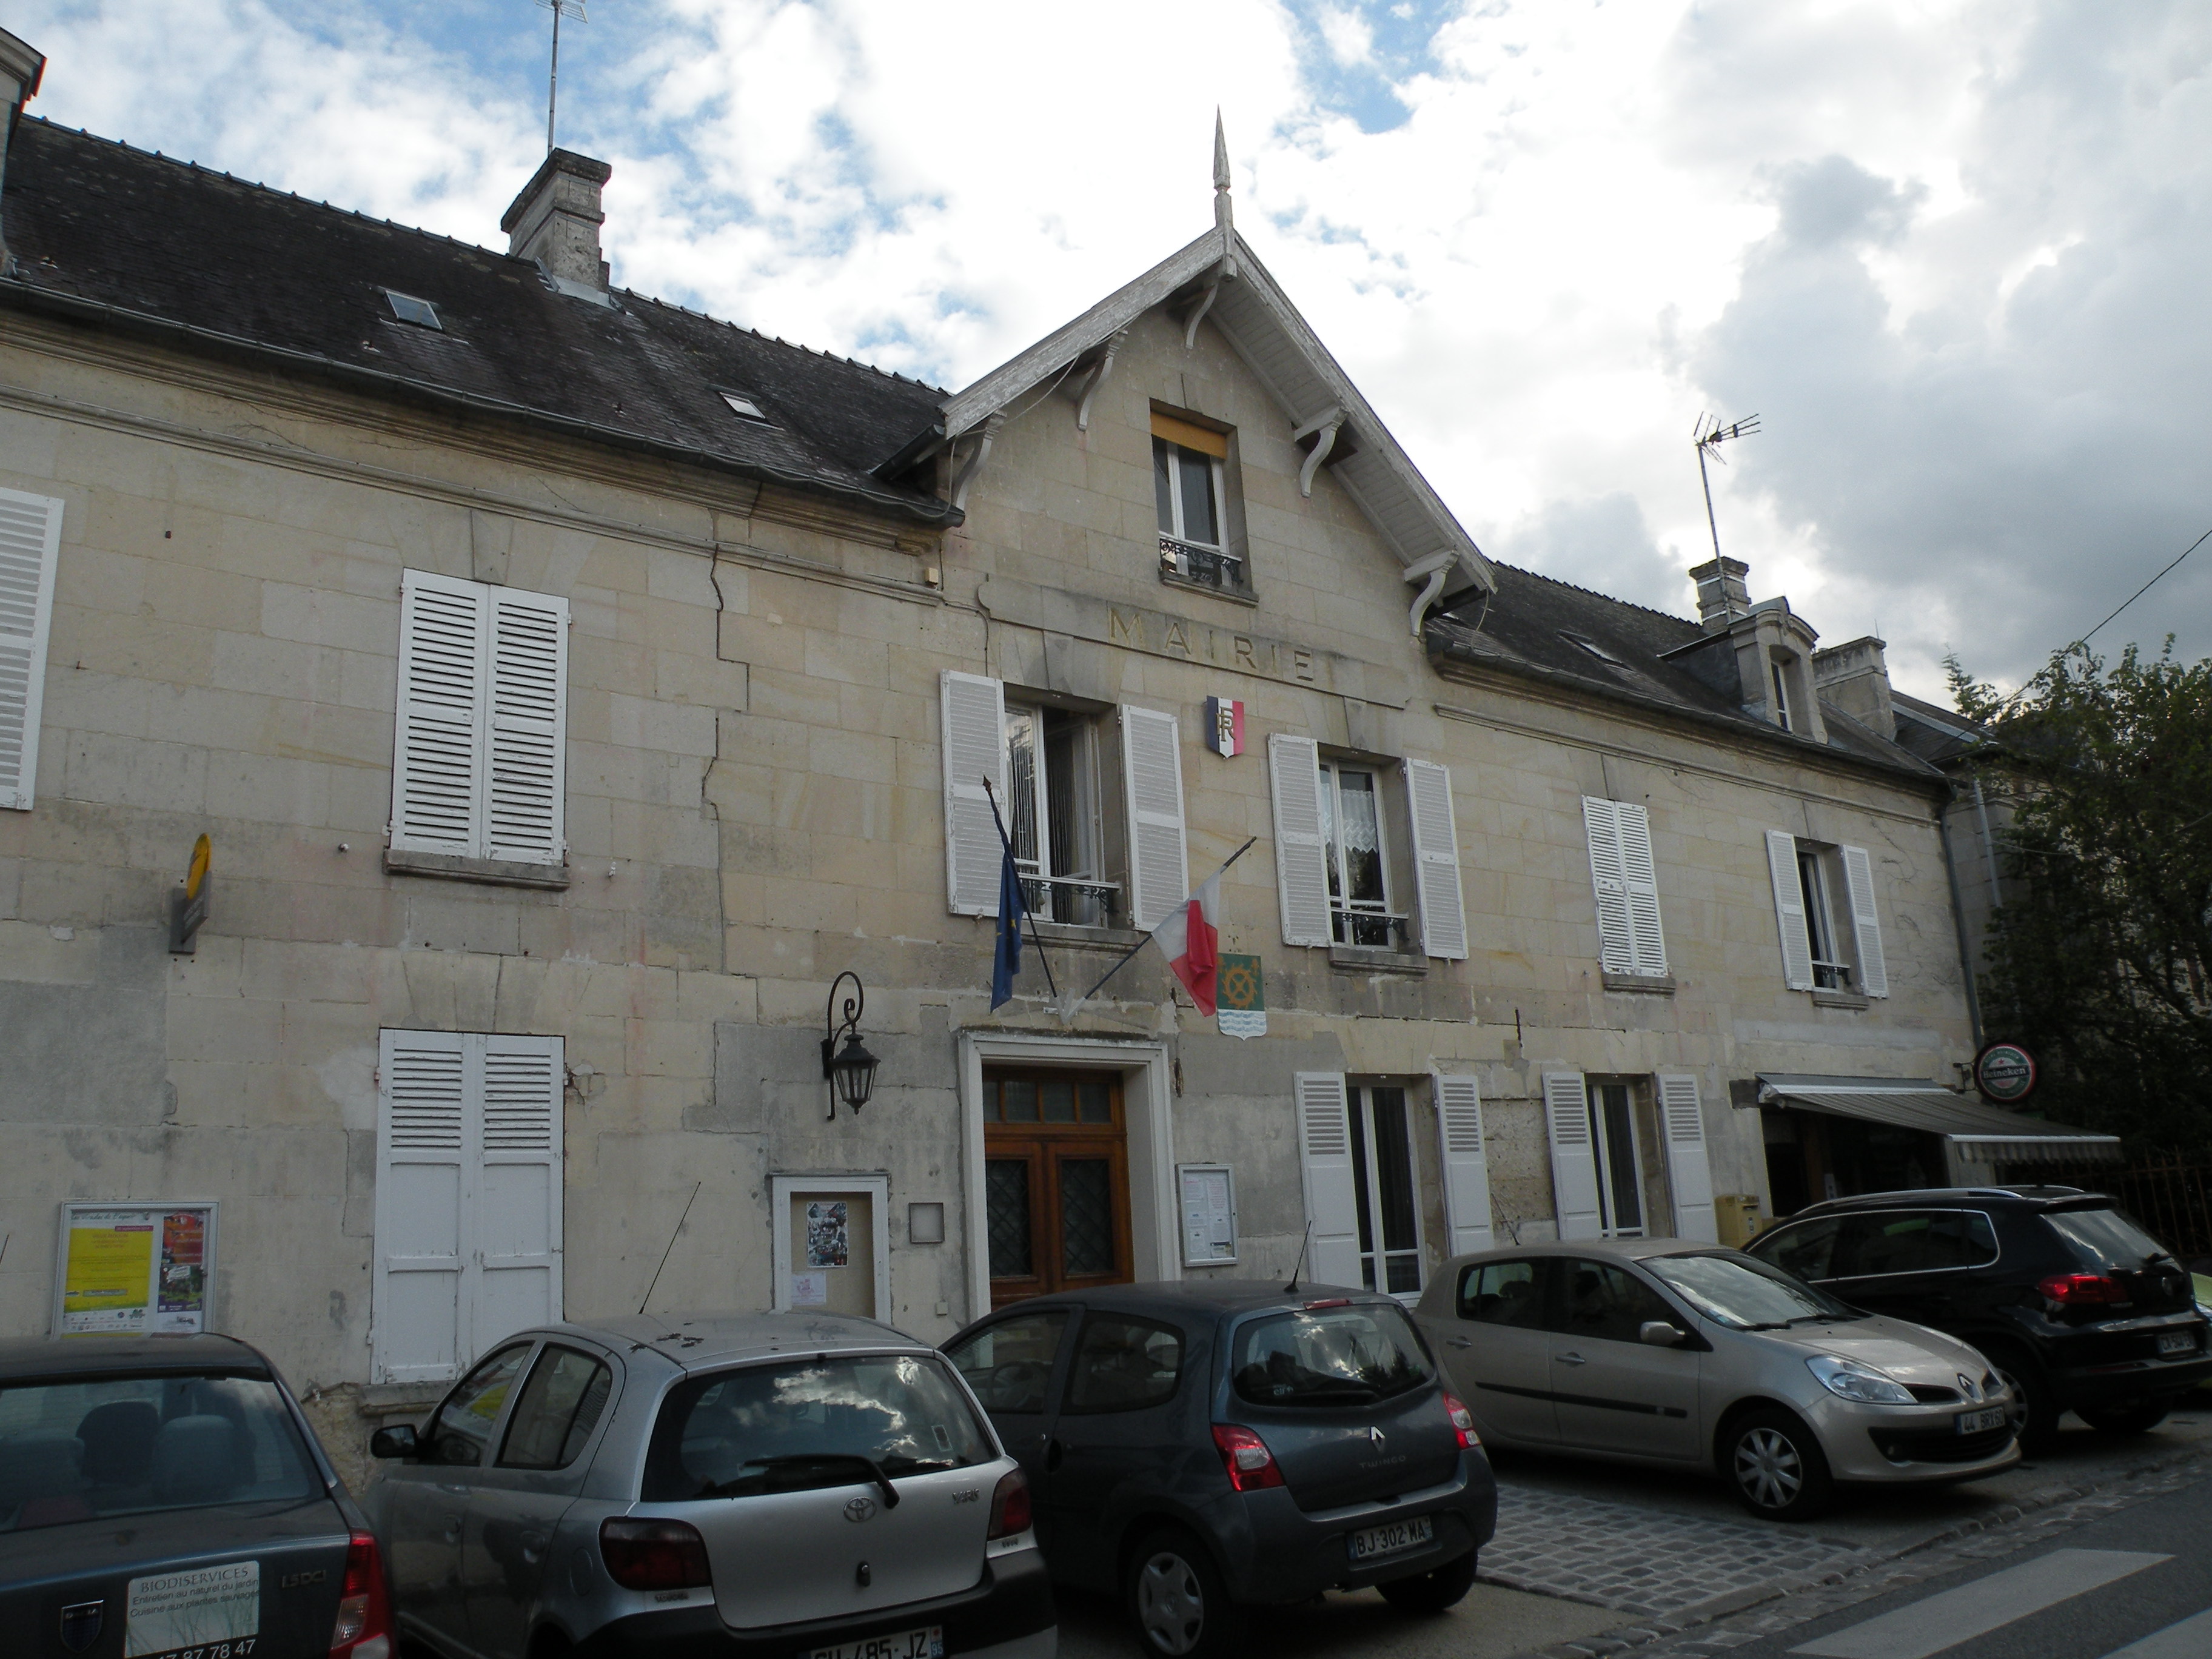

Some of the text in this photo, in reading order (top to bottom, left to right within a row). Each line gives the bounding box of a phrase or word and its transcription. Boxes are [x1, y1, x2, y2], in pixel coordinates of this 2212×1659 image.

[1109, 607, 1315, 682] MAIRIE
[1983, 1067, 2026, 1079] Heineken
[1359, 1455, 1406, 1469] TWINGO
[952, 1489, 980, 1504] YARIS
[141, 1566, 249, 1594] BIODISERVICES
[133, 1592, 176, 1606] Entretien
[190, 1584, 220, 1596] naturel
[222, 1581, 233, 1590] du
[235, 1578, 259, 1590] jardin
[130, 1605, 168, 1618] Cuisine
[167, 1603, 184, 1612] aux
[186, 1595, 218, 1609] plantes
[210, 1644, 230, 1659] 78
[235, 1639, 256, 1655] 47
[931, 1641, 943, 1656] 95
